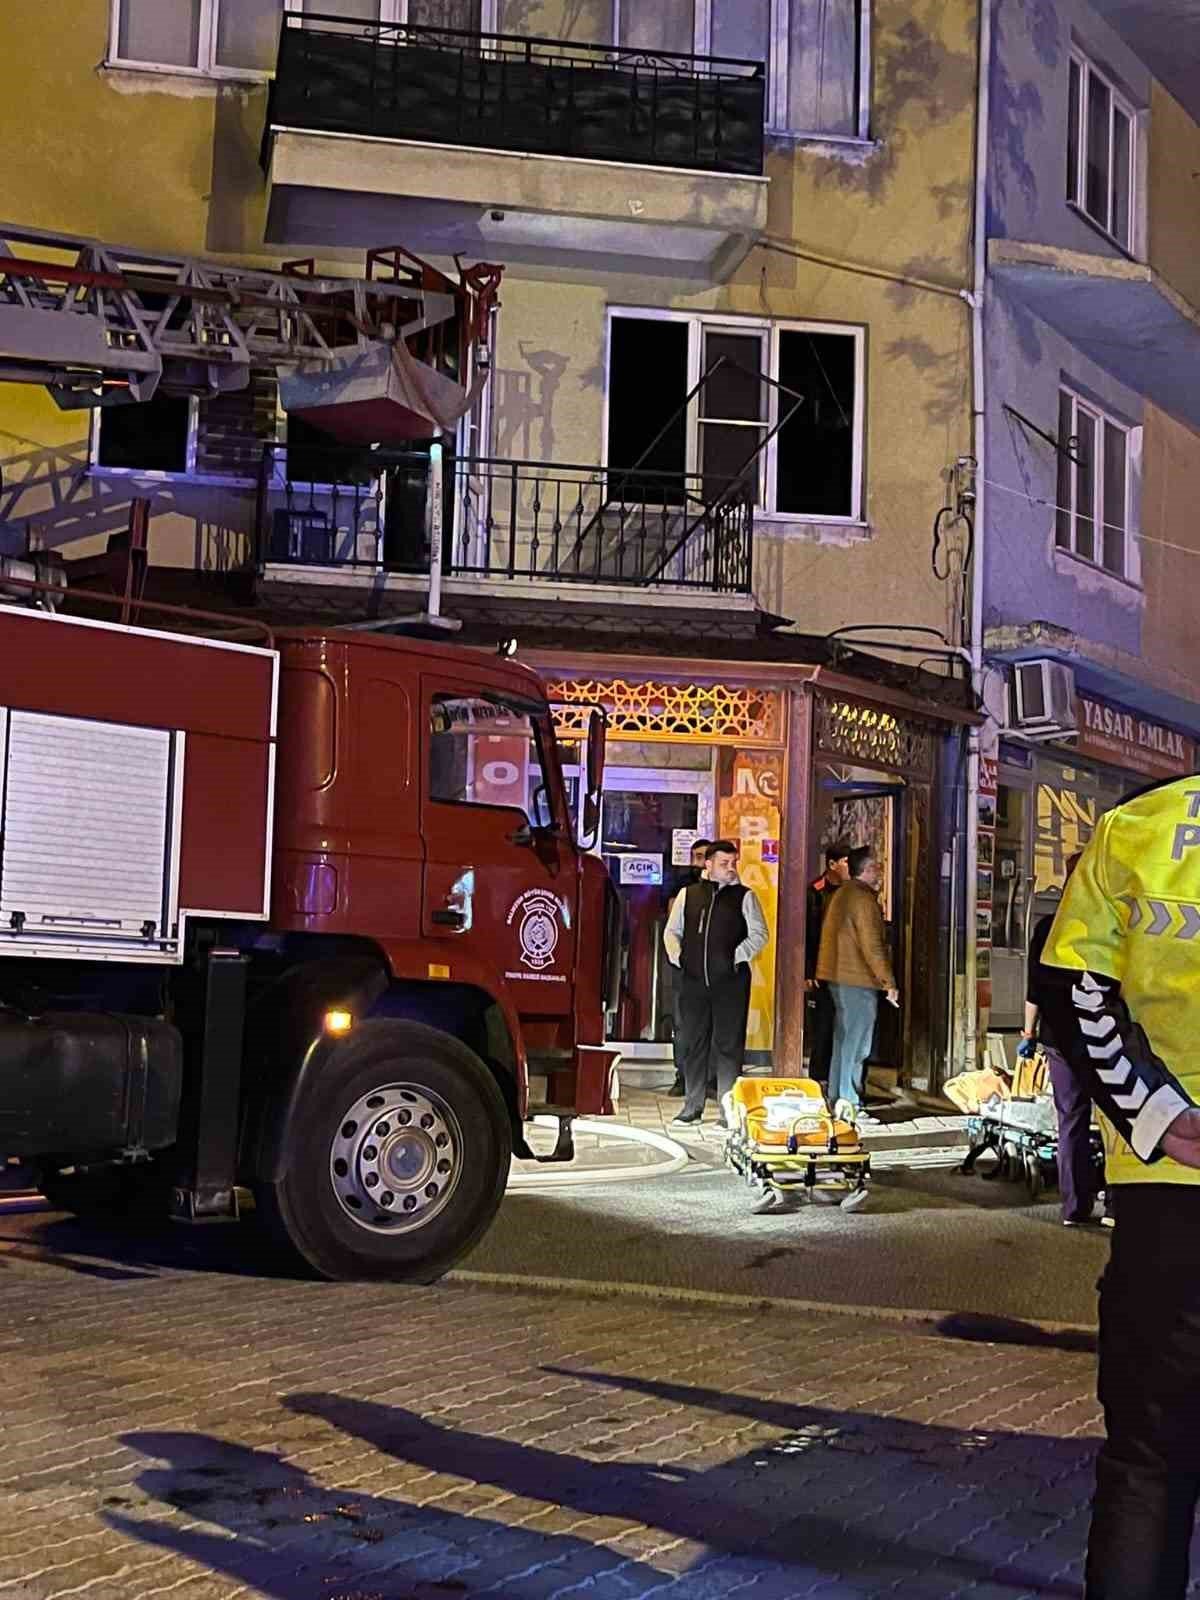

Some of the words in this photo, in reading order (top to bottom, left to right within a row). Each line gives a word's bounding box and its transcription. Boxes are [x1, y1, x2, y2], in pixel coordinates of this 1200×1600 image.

[1083, 700, 1134, 742] YAŞAR
[1138, 721, 1185, 760] EMLAK
[628, 862, 654, 873] AÇIK
